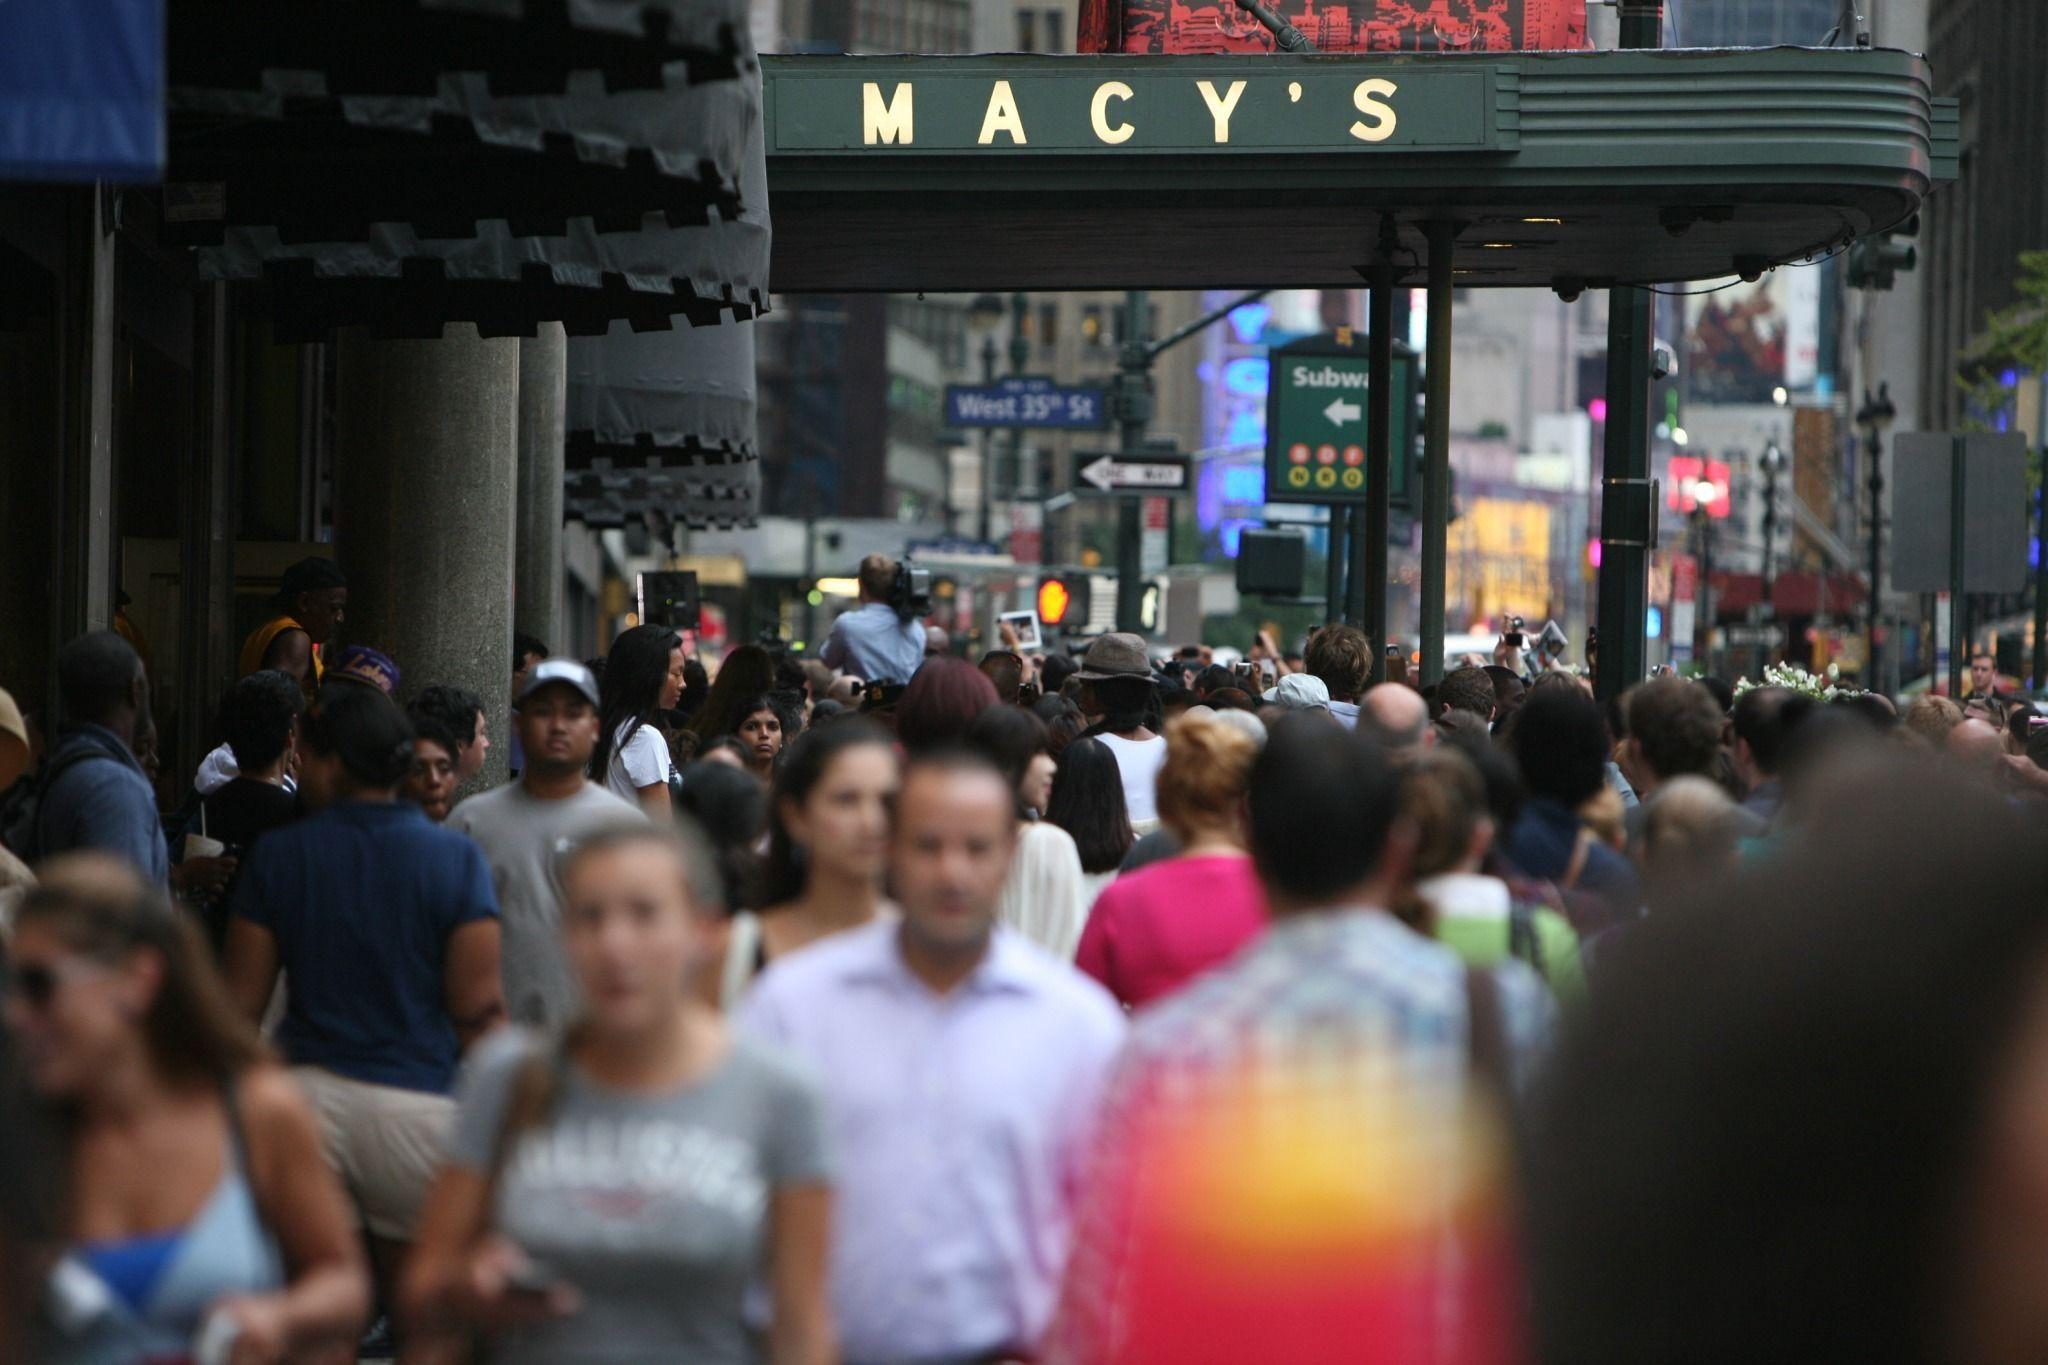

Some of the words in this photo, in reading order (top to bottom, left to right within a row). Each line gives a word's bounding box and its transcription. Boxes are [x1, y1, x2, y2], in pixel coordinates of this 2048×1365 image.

[862, 79, 1399, 145] MACY'S
[1292, 366, 1369, 389] Subw
[956, 393, 1016, 419] West
[1020, 393, 1063, 420] 35th
[1068, 393, 1093, 420] St
[1096, 463, 1126, 480] ONE
